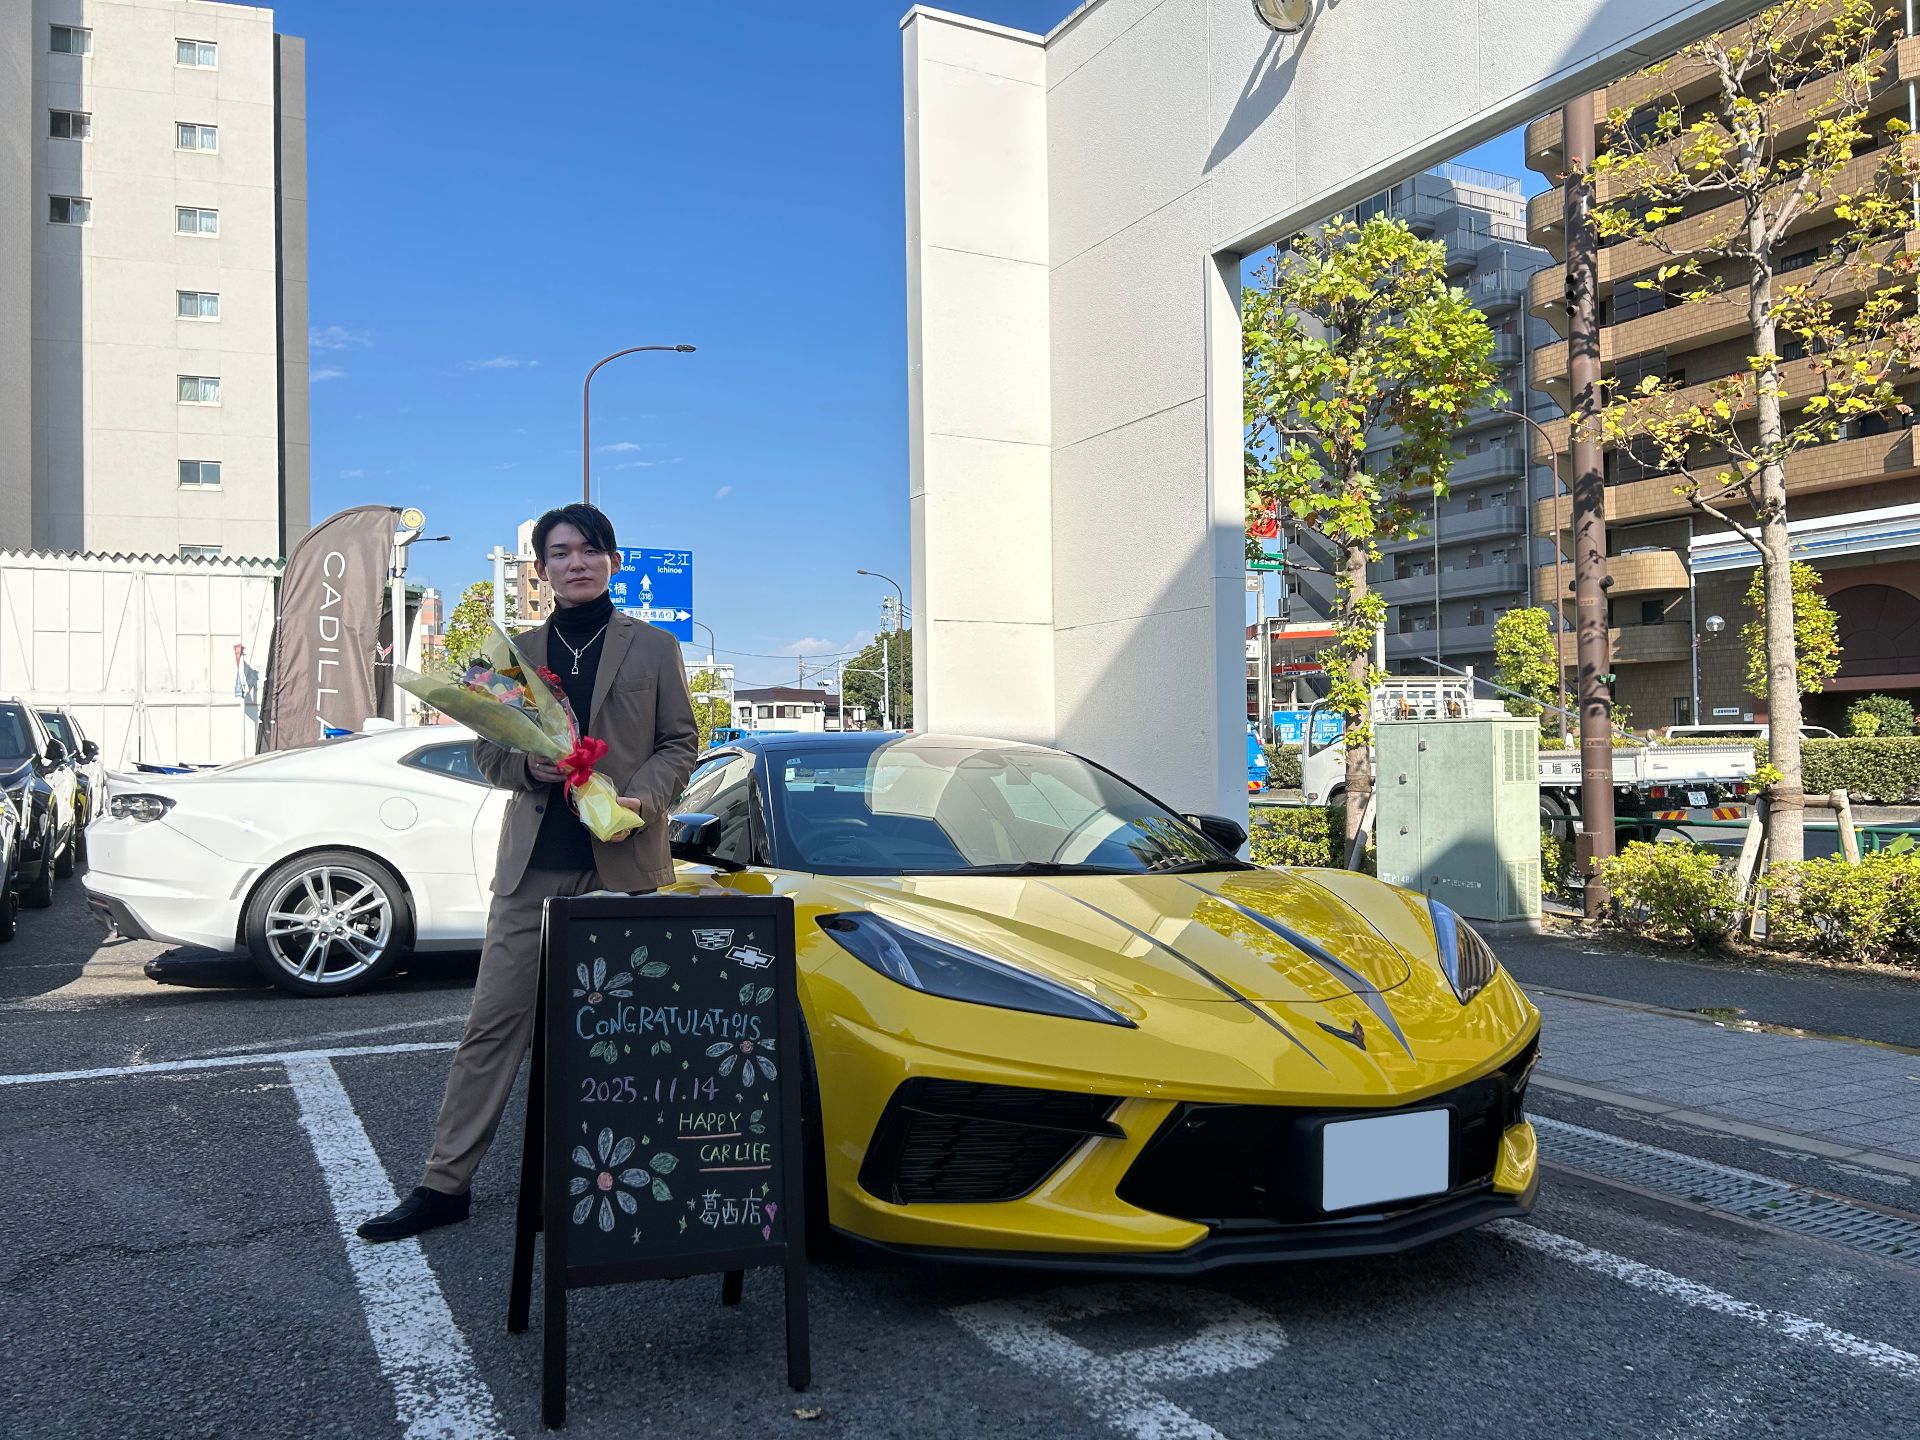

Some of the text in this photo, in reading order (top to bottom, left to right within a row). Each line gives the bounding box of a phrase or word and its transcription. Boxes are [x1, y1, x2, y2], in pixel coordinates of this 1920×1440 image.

[650, 553, 690, 566] 一之江
[580, 1076, 719, 1103] 2025.11.14
[679, 1111, 742, 1132] HAPPY
[700, 1143, 771, 1163] CAR LIFE
[699, 1188, 763, 1229] 葛西店
